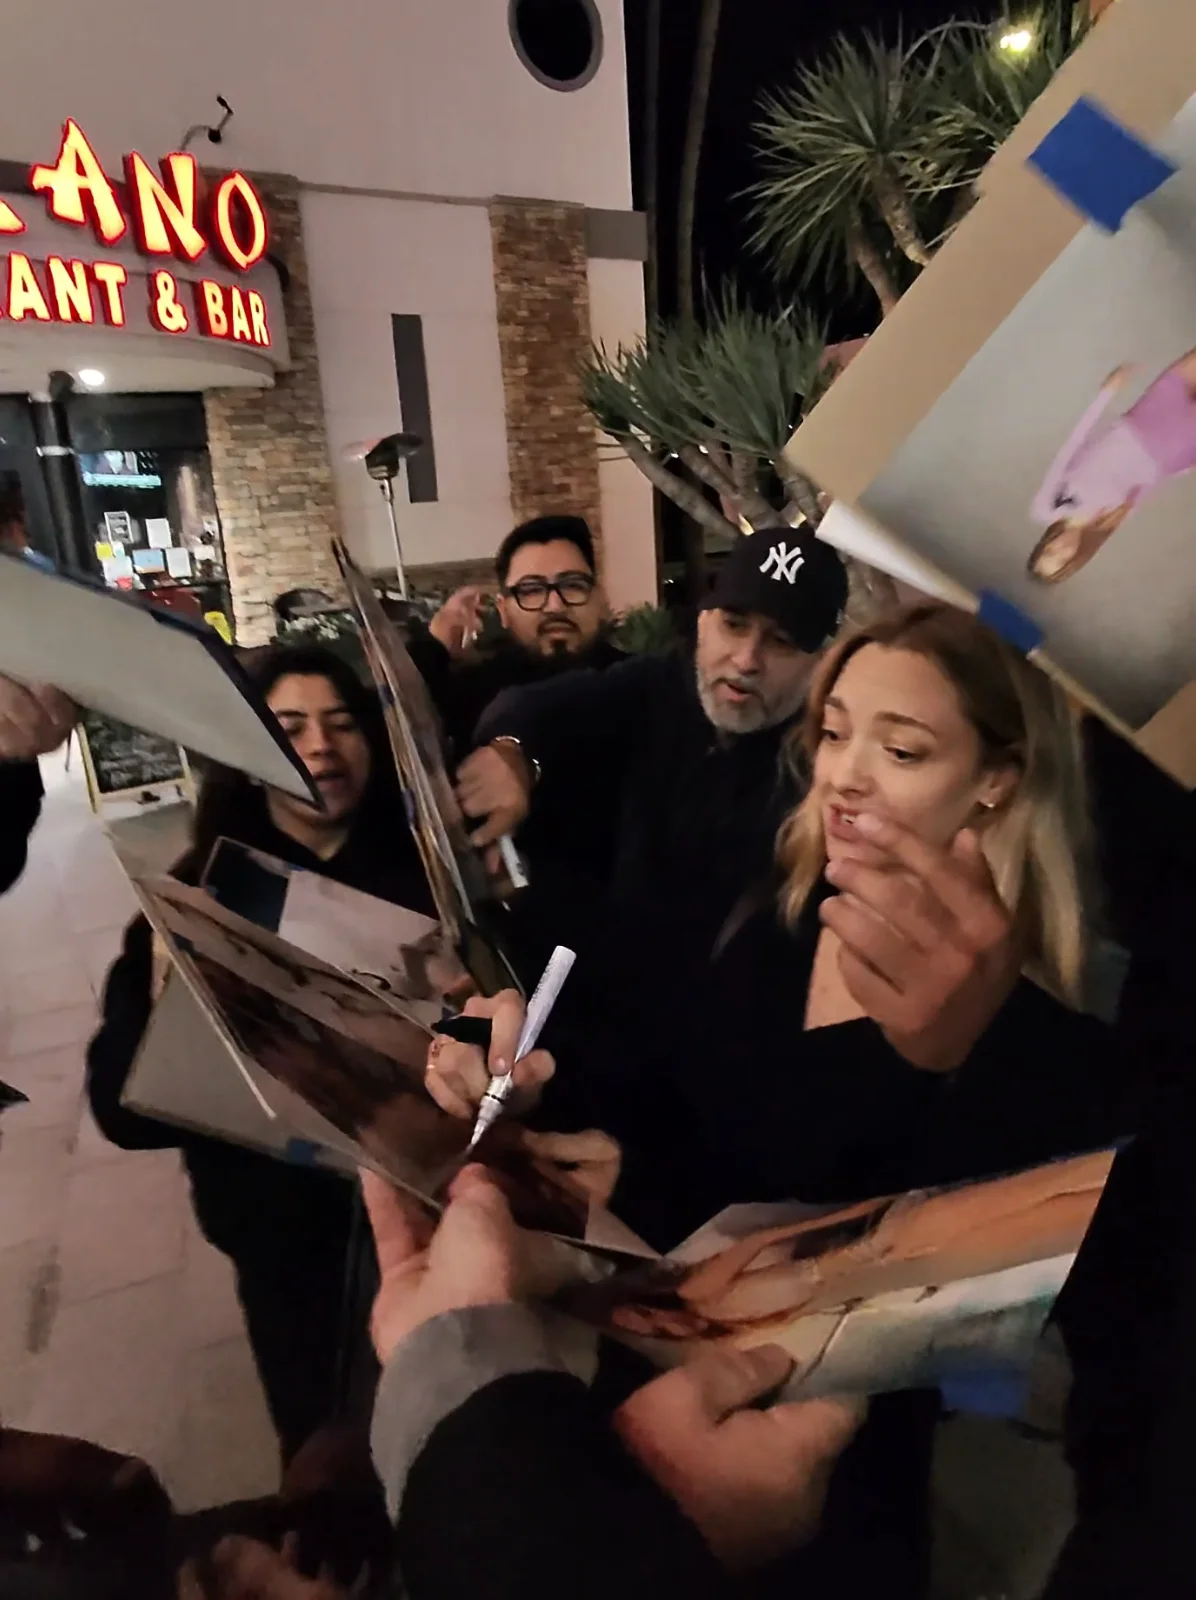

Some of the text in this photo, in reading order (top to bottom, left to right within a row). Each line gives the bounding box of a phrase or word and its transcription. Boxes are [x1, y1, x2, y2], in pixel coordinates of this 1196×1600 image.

[0, 251, 271, 347] ANT & BAR
[758, 541, 805, 585] NY
